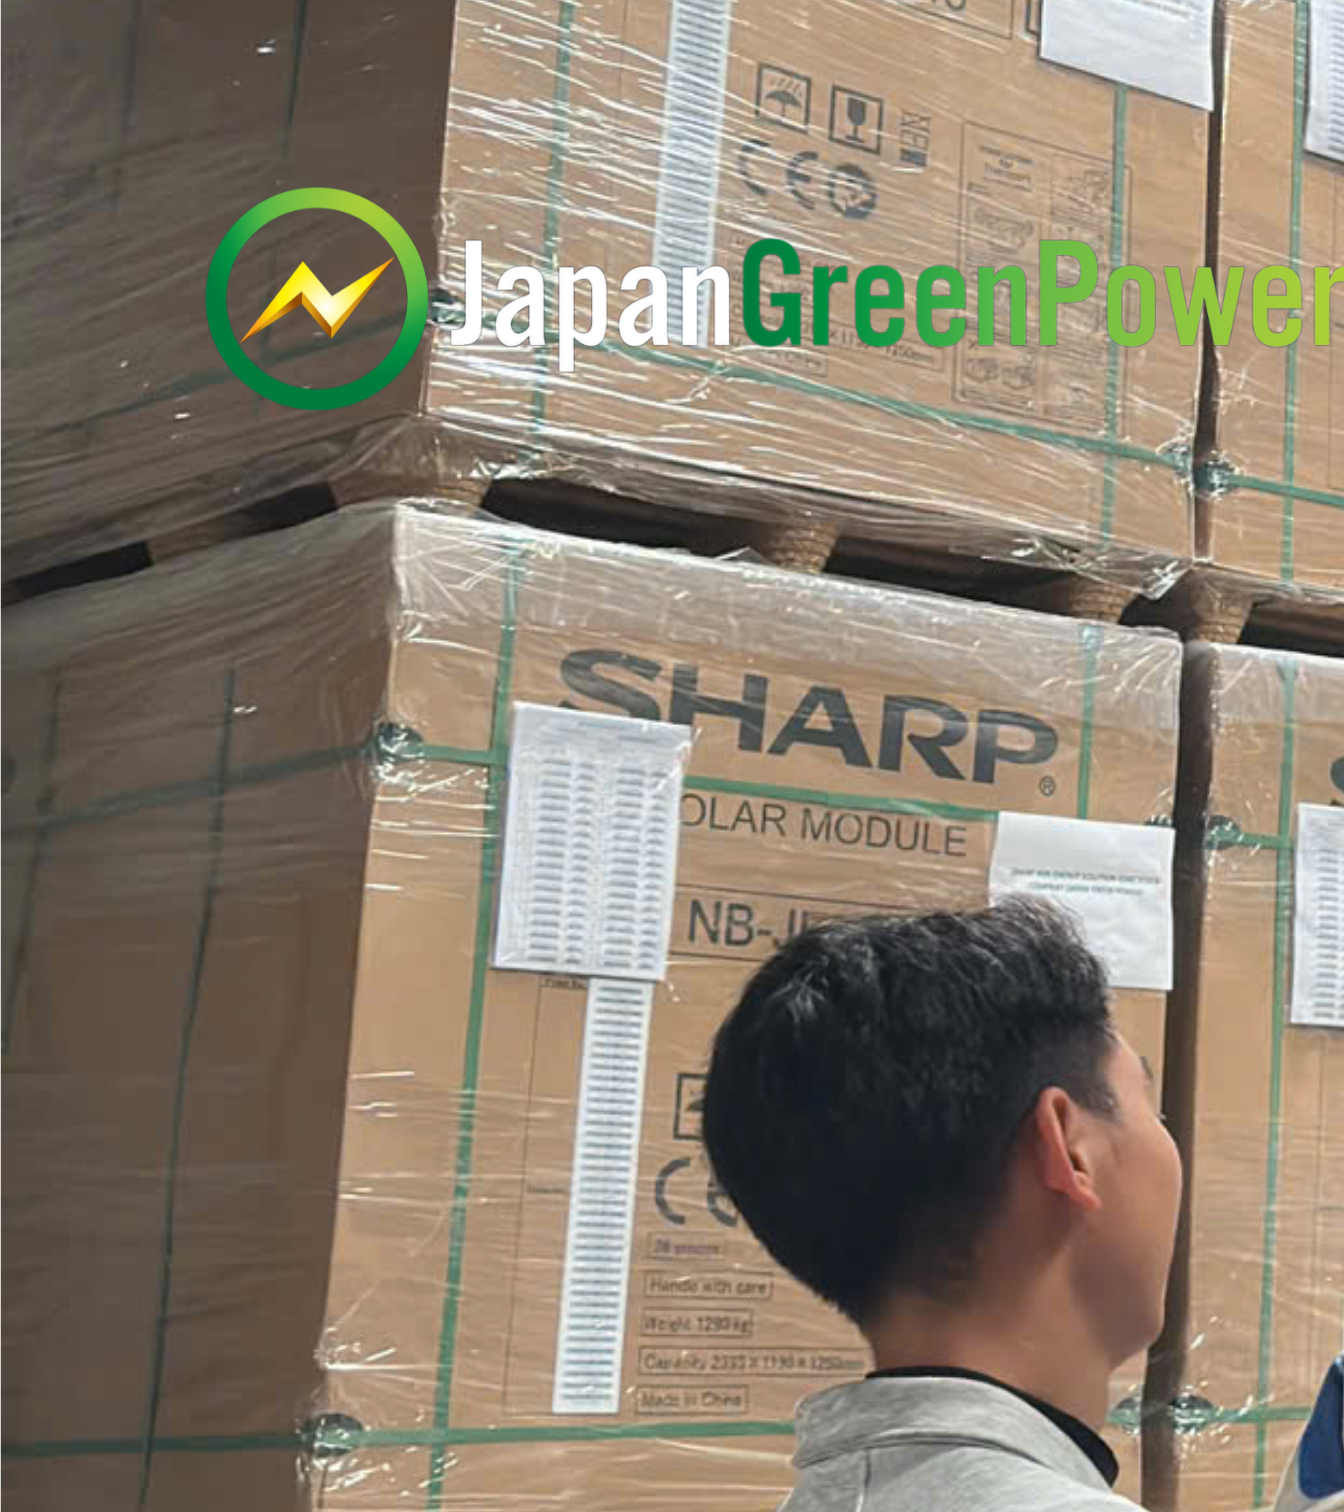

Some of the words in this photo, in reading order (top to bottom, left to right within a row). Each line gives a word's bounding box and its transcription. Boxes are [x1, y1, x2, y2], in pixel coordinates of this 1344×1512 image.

[560, 648, 1058, 783] SHARP
[680, 793, 787, 837] OLAR
[802, 807, 967, 857] MODULE
